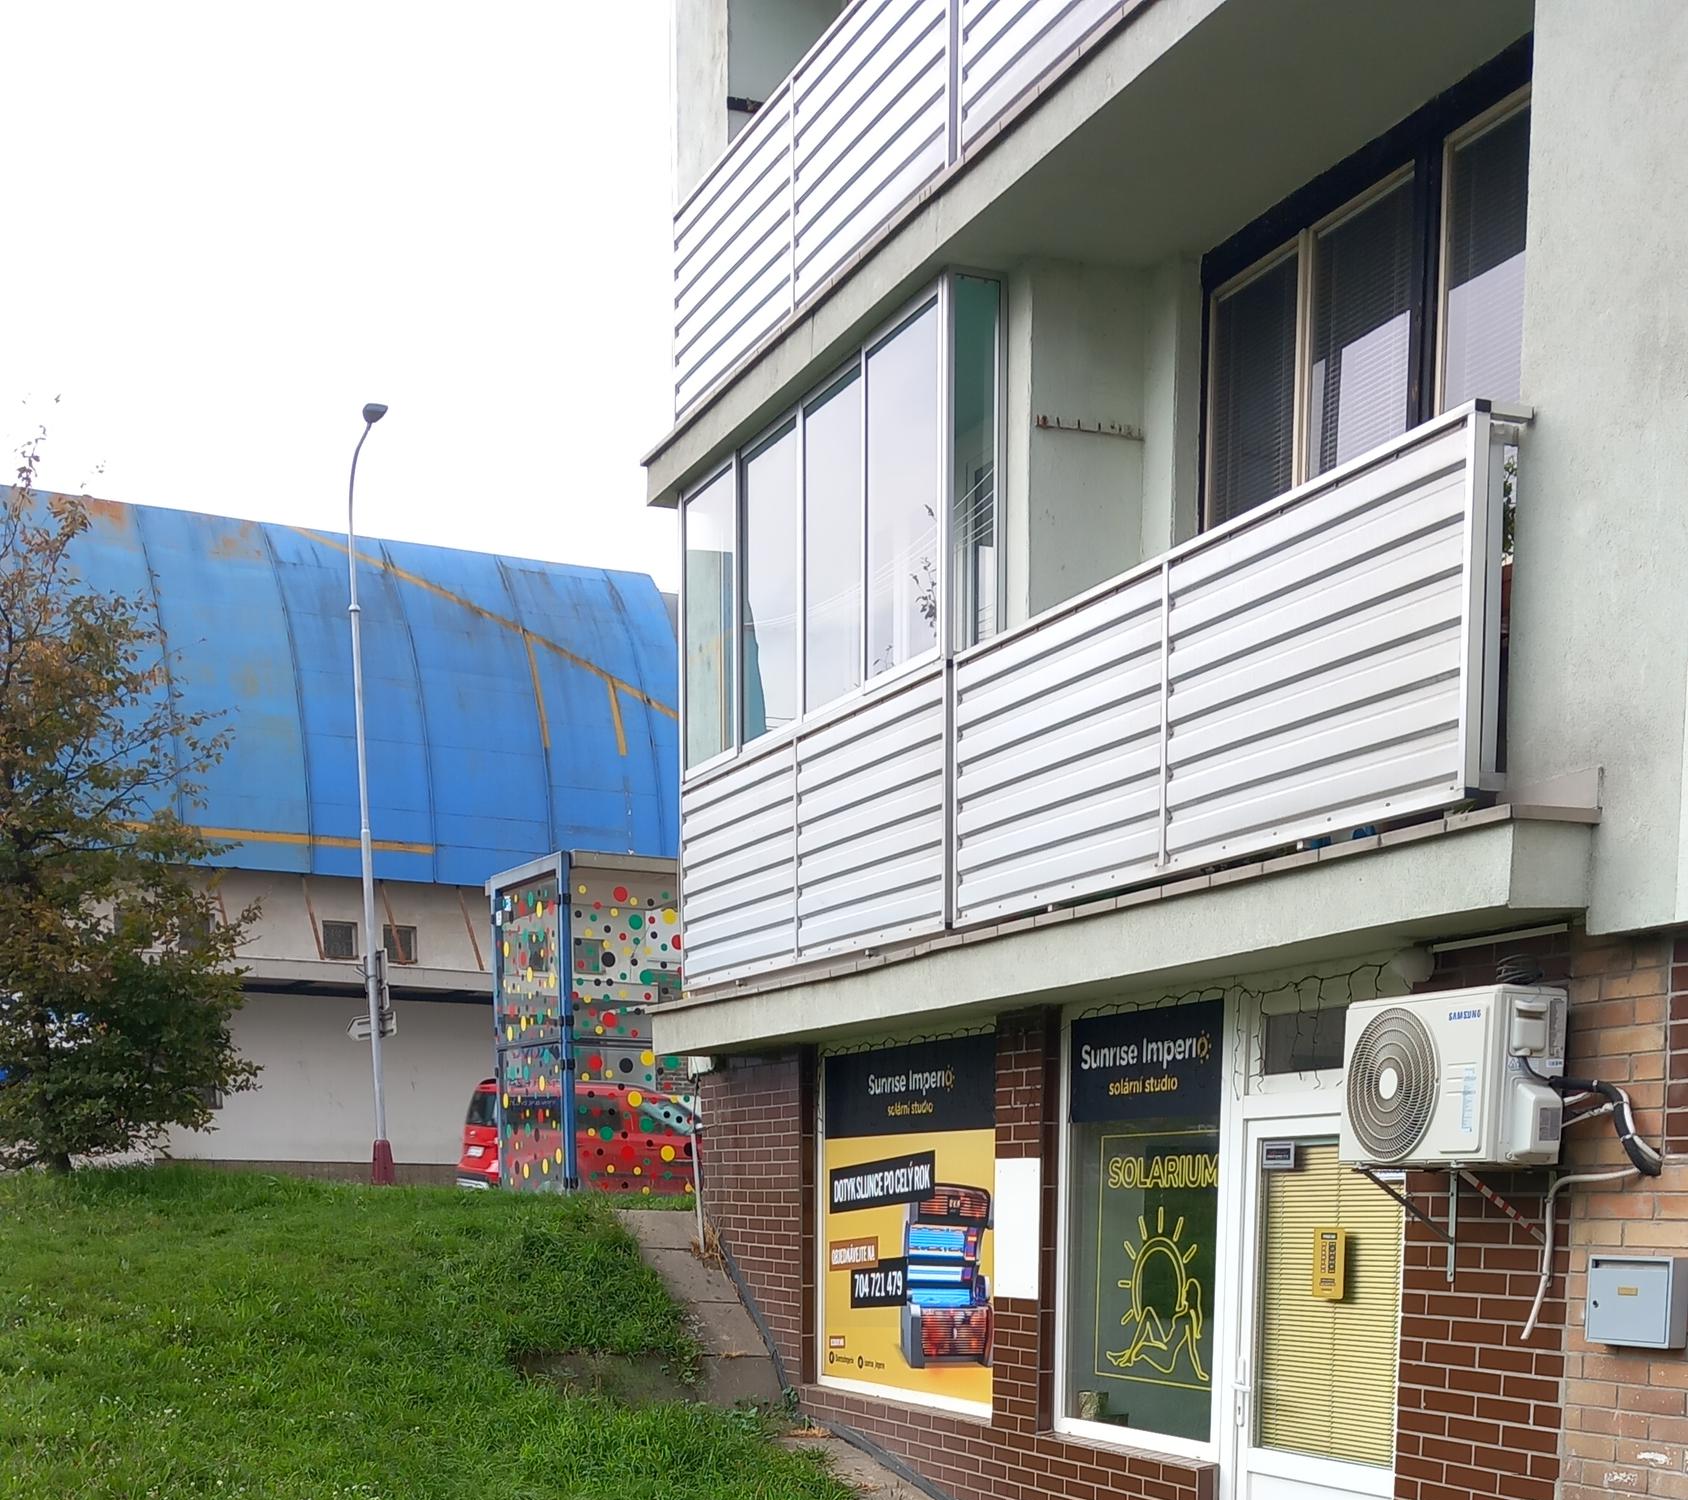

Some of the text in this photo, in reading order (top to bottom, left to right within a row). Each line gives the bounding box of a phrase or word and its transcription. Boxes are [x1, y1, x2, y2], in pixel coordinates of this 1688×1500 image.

[1448, 1009, 1482, 1021] SAMSUNG
[1080, 1037, 1209, 1070] Sunrise Imperio
[868, 1069, 953, 1096] Sunrise Imperio
[1108, 1074, 1178, 1096] solární studio
[887, 1099, 934, 1117] solární studio
[833, 1160, 931, 1203] DOTYK SLUNCE PO CELÝ ROK
[1107, 1153, 1220, 1189] SOLARIUM
[854, 1270, 903, 1298] 704 721 479
